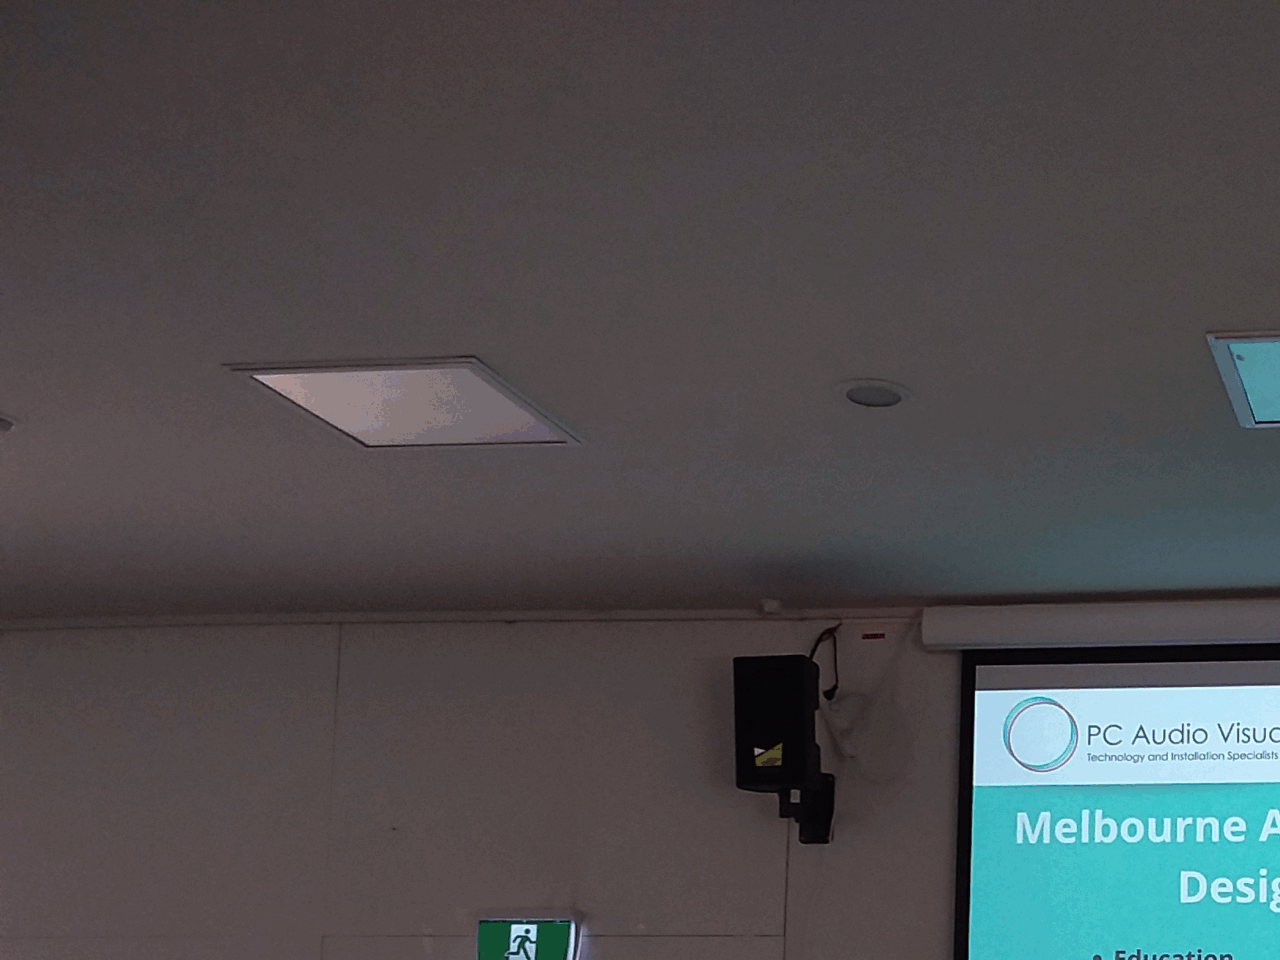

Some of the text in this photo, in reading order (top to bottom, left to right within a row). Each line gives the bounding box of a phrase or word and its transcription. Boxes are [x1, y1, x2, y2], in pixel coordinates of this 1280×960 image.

[1086, 724, 1123, 746] PC
[1131, 722, 1209, 746] Audio
[1086, 750, 1279, 764] Technology and Installation Specialists
[1015, 809, 1247, 845] Melbourne
